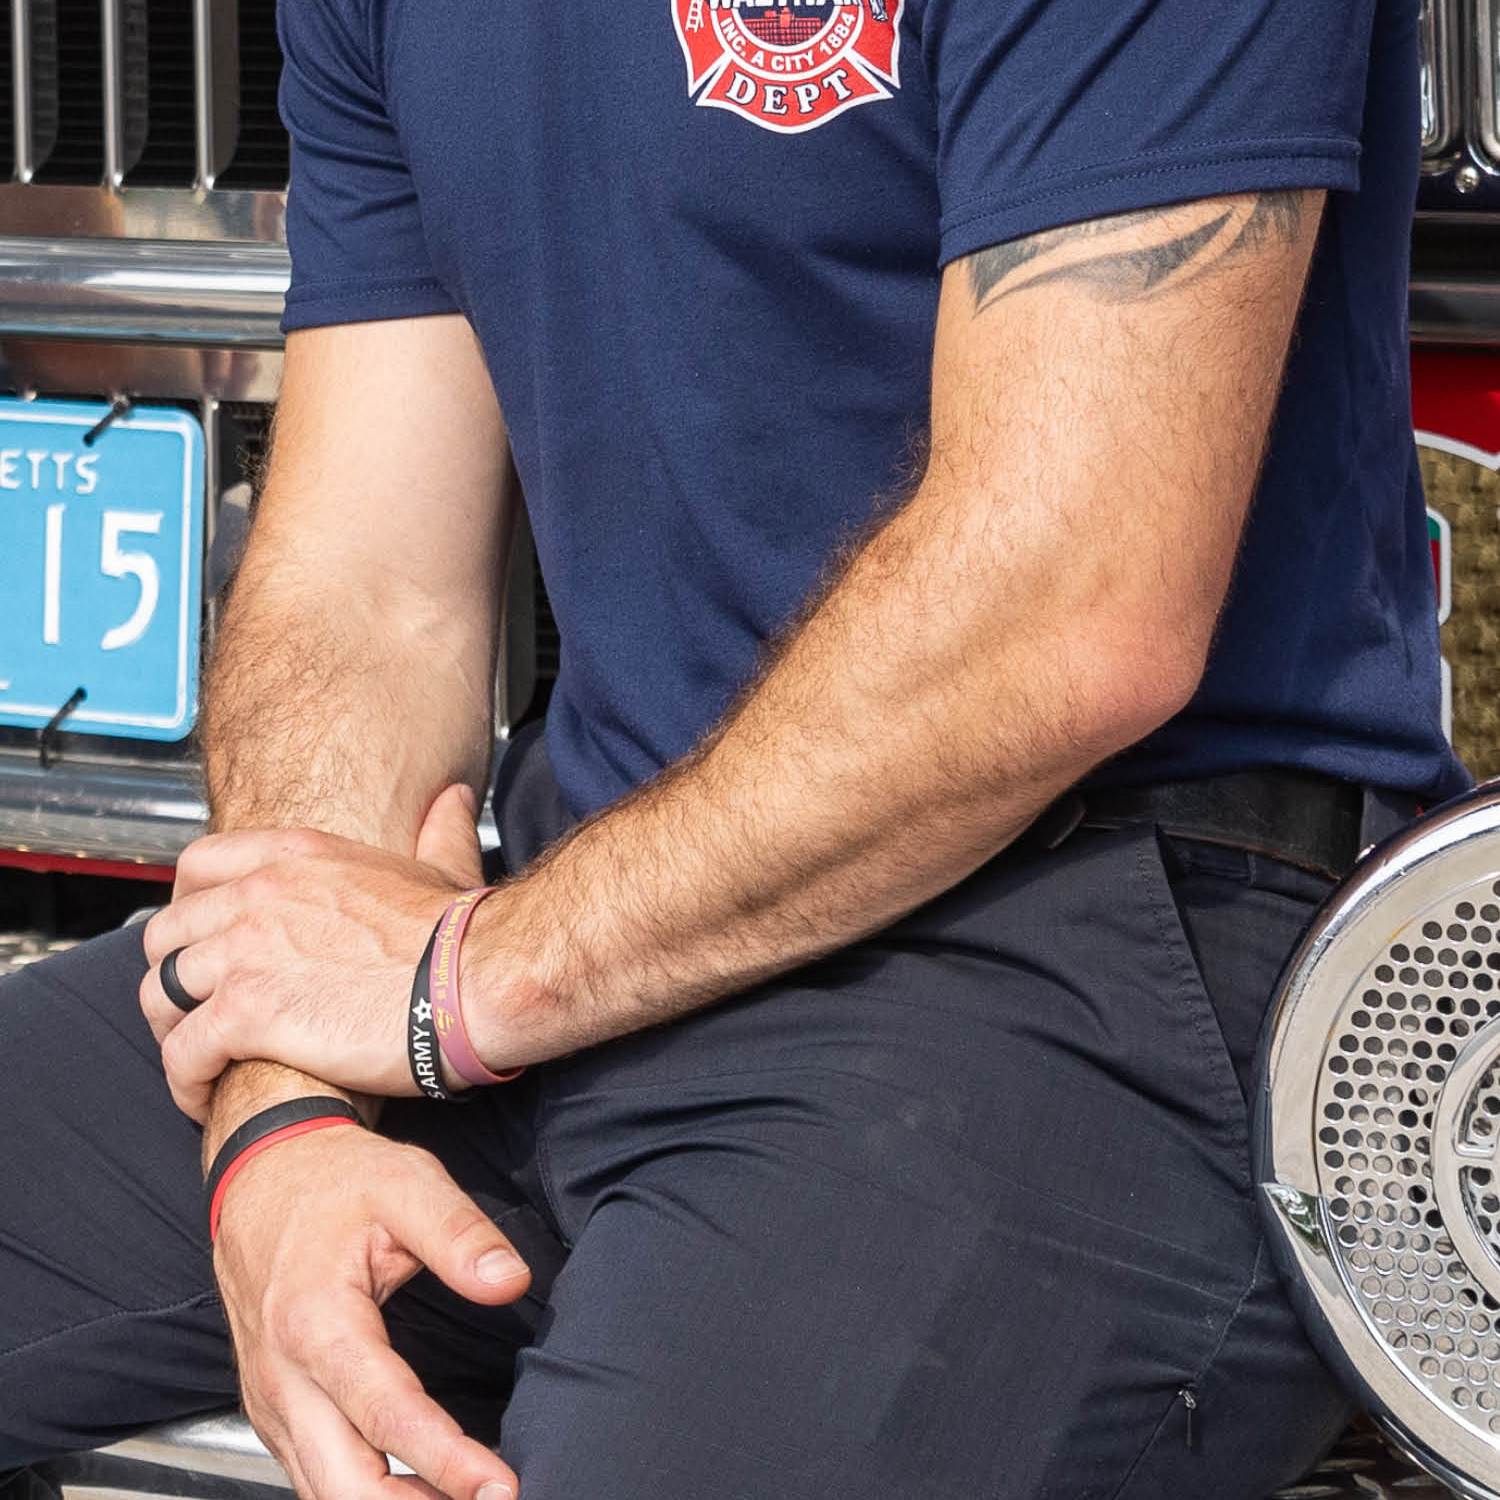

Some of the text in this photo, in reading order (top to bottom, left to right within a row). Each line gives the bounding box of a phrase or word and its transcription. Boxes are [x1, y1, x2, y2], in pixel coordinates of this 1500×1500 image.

[720, 11, 857, 72] INC. A CITY 1884
[725, 67, 852, 114] DEPT
[412, 1025, 440, 1090] ARMY
